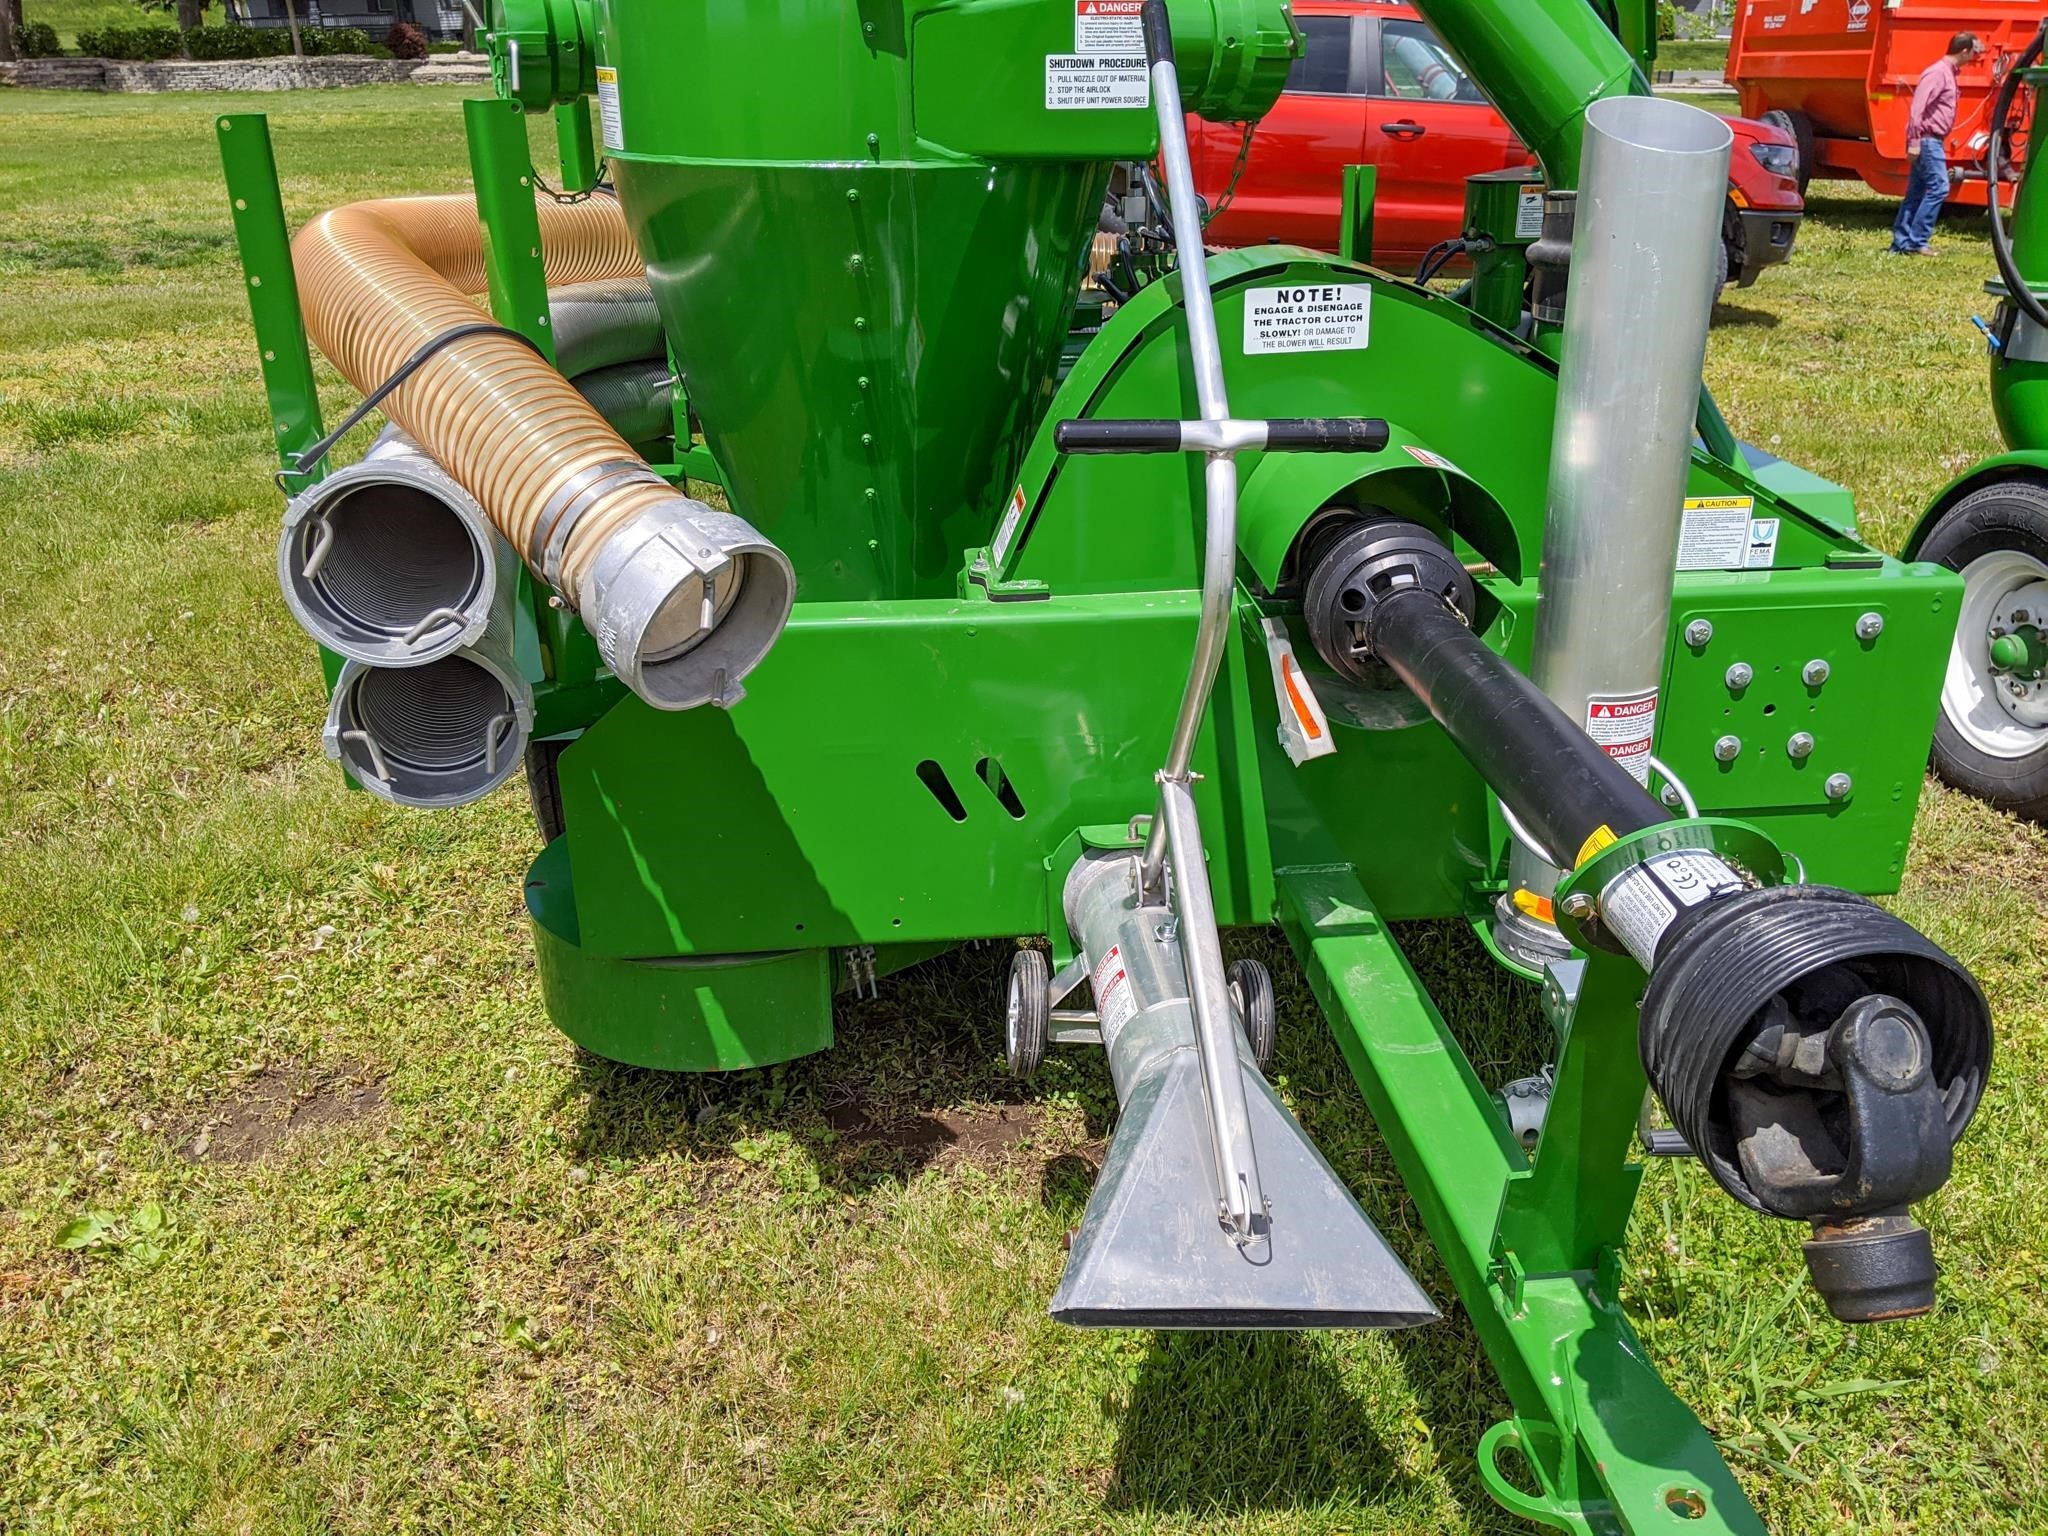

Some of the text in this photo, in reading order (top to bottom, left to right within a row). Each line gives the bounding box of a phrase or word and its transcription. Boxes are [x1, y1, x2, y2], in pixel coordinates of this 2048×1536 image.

[1099, 2, 1142, 12] DANGER
[1049, 58, 1146, 68] SHUTDOWN PROCEDURE
[1277, 288, 1342, 303] NOTE!
[1254, 306, 1294, 315] ENGAGE
[1307, 303, 1363, 312] DISENGAGE
[1276, 317, 1321, 325] TRACTOR
[1325, 315, 1363, 323] CLUTCH
[1260, 329, 1300, 338] SLOWLY!
[1316, 327, 1344, 335] DAMAGE
[1278, 339, 1306, 348] BLOWER
[1327, 337, 1352, 345] RESULT
[1614, 701, 1653, 716] DANGER
[1609, 741, 1648, 756] DANGER
[1638, 886, 1647, 896] PTO
[1645, 894, 1654, 904] USE
[1652, 901, 1660, 913] NOT
[1658, 910, 1666, 918] DO
